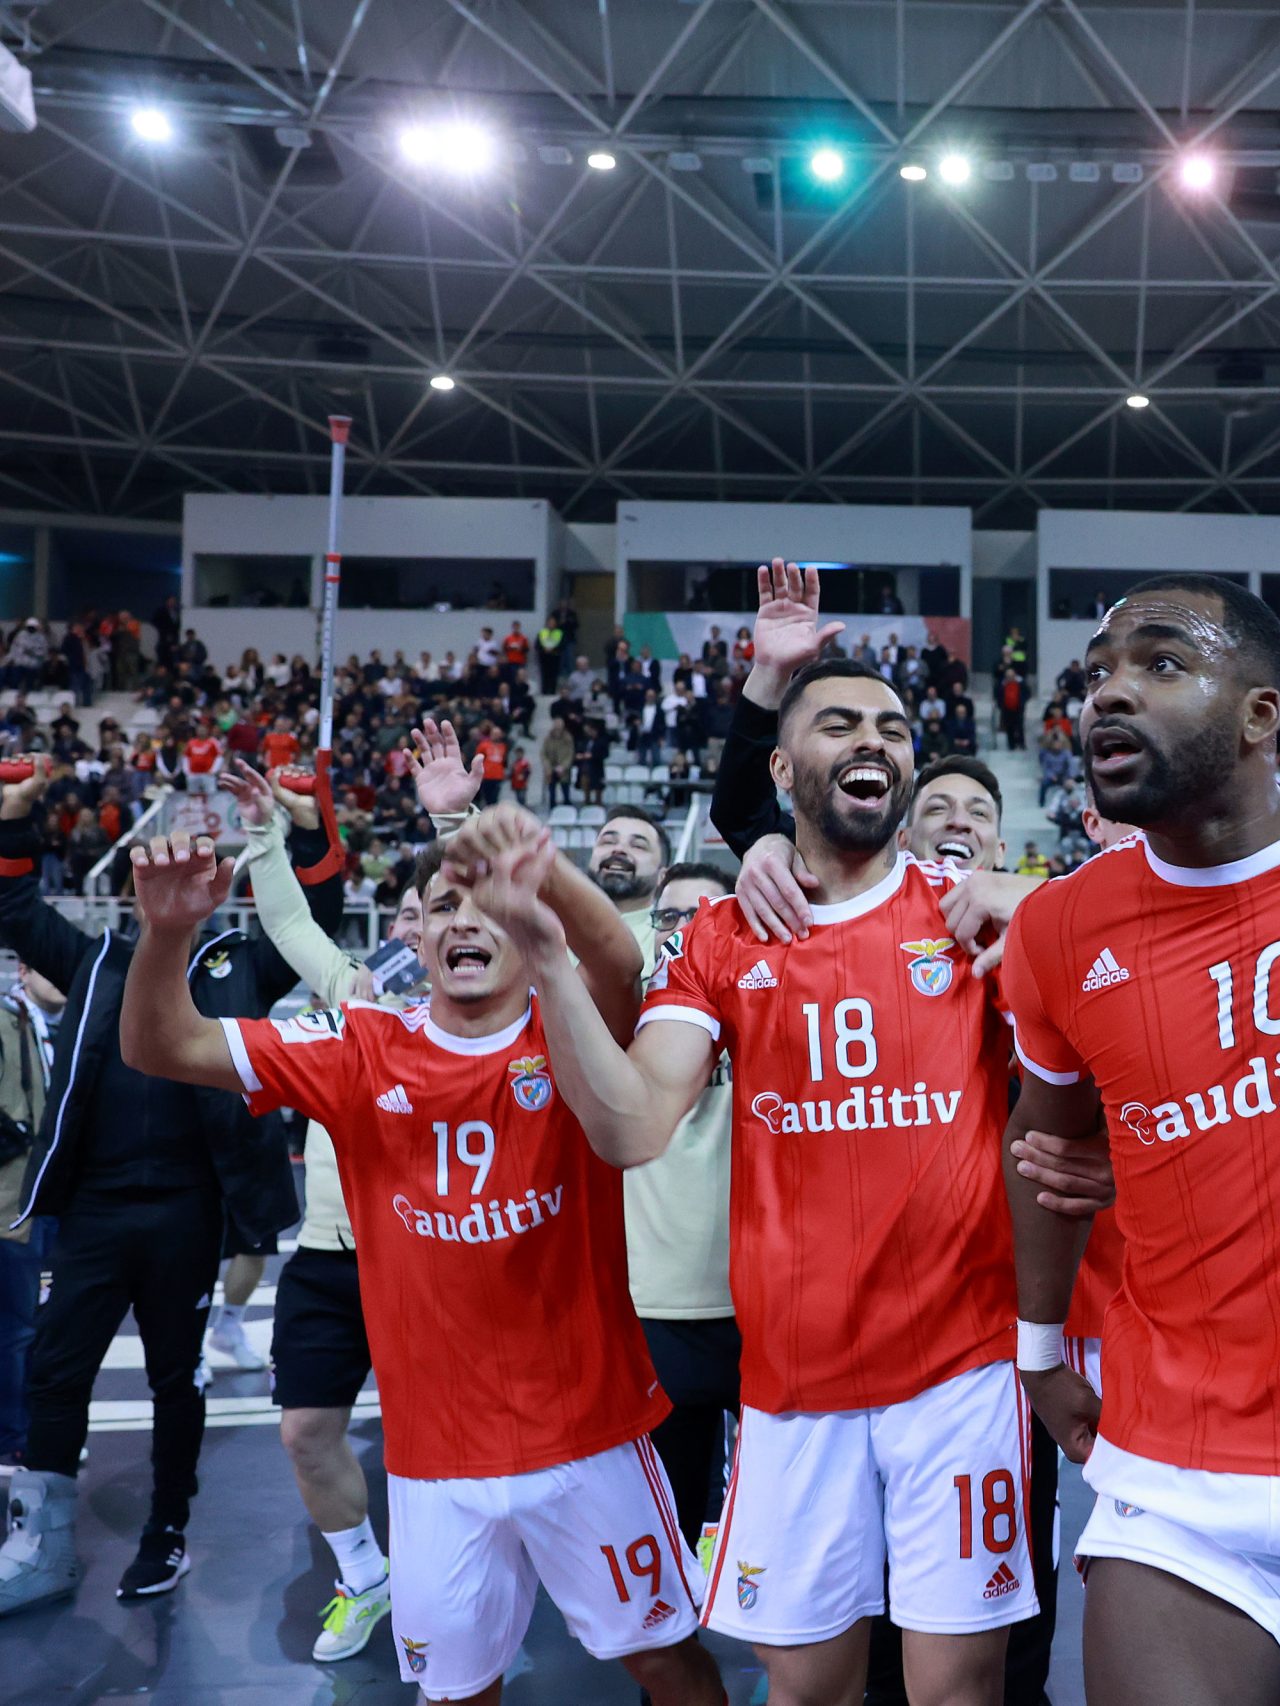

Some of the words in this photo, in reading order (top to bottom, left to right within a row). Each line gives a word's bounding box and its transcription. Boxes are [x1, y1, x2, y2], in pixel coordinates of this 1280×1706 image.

[737, 976, 778, 990] adidas
[1081, 966, 1131, 993] adidas
[801, 996, 878, 1083] 18
[780, 1080, 963, 1135] auditiv
[431, 1119, 496, 1197] 19
[412, 1183, 564, 1245] auditiv
[953, 1467, 1018, 1560] 18
[599, 1533, 662, 1604] 19
[982, 1578, 1022, 1600] adidas
